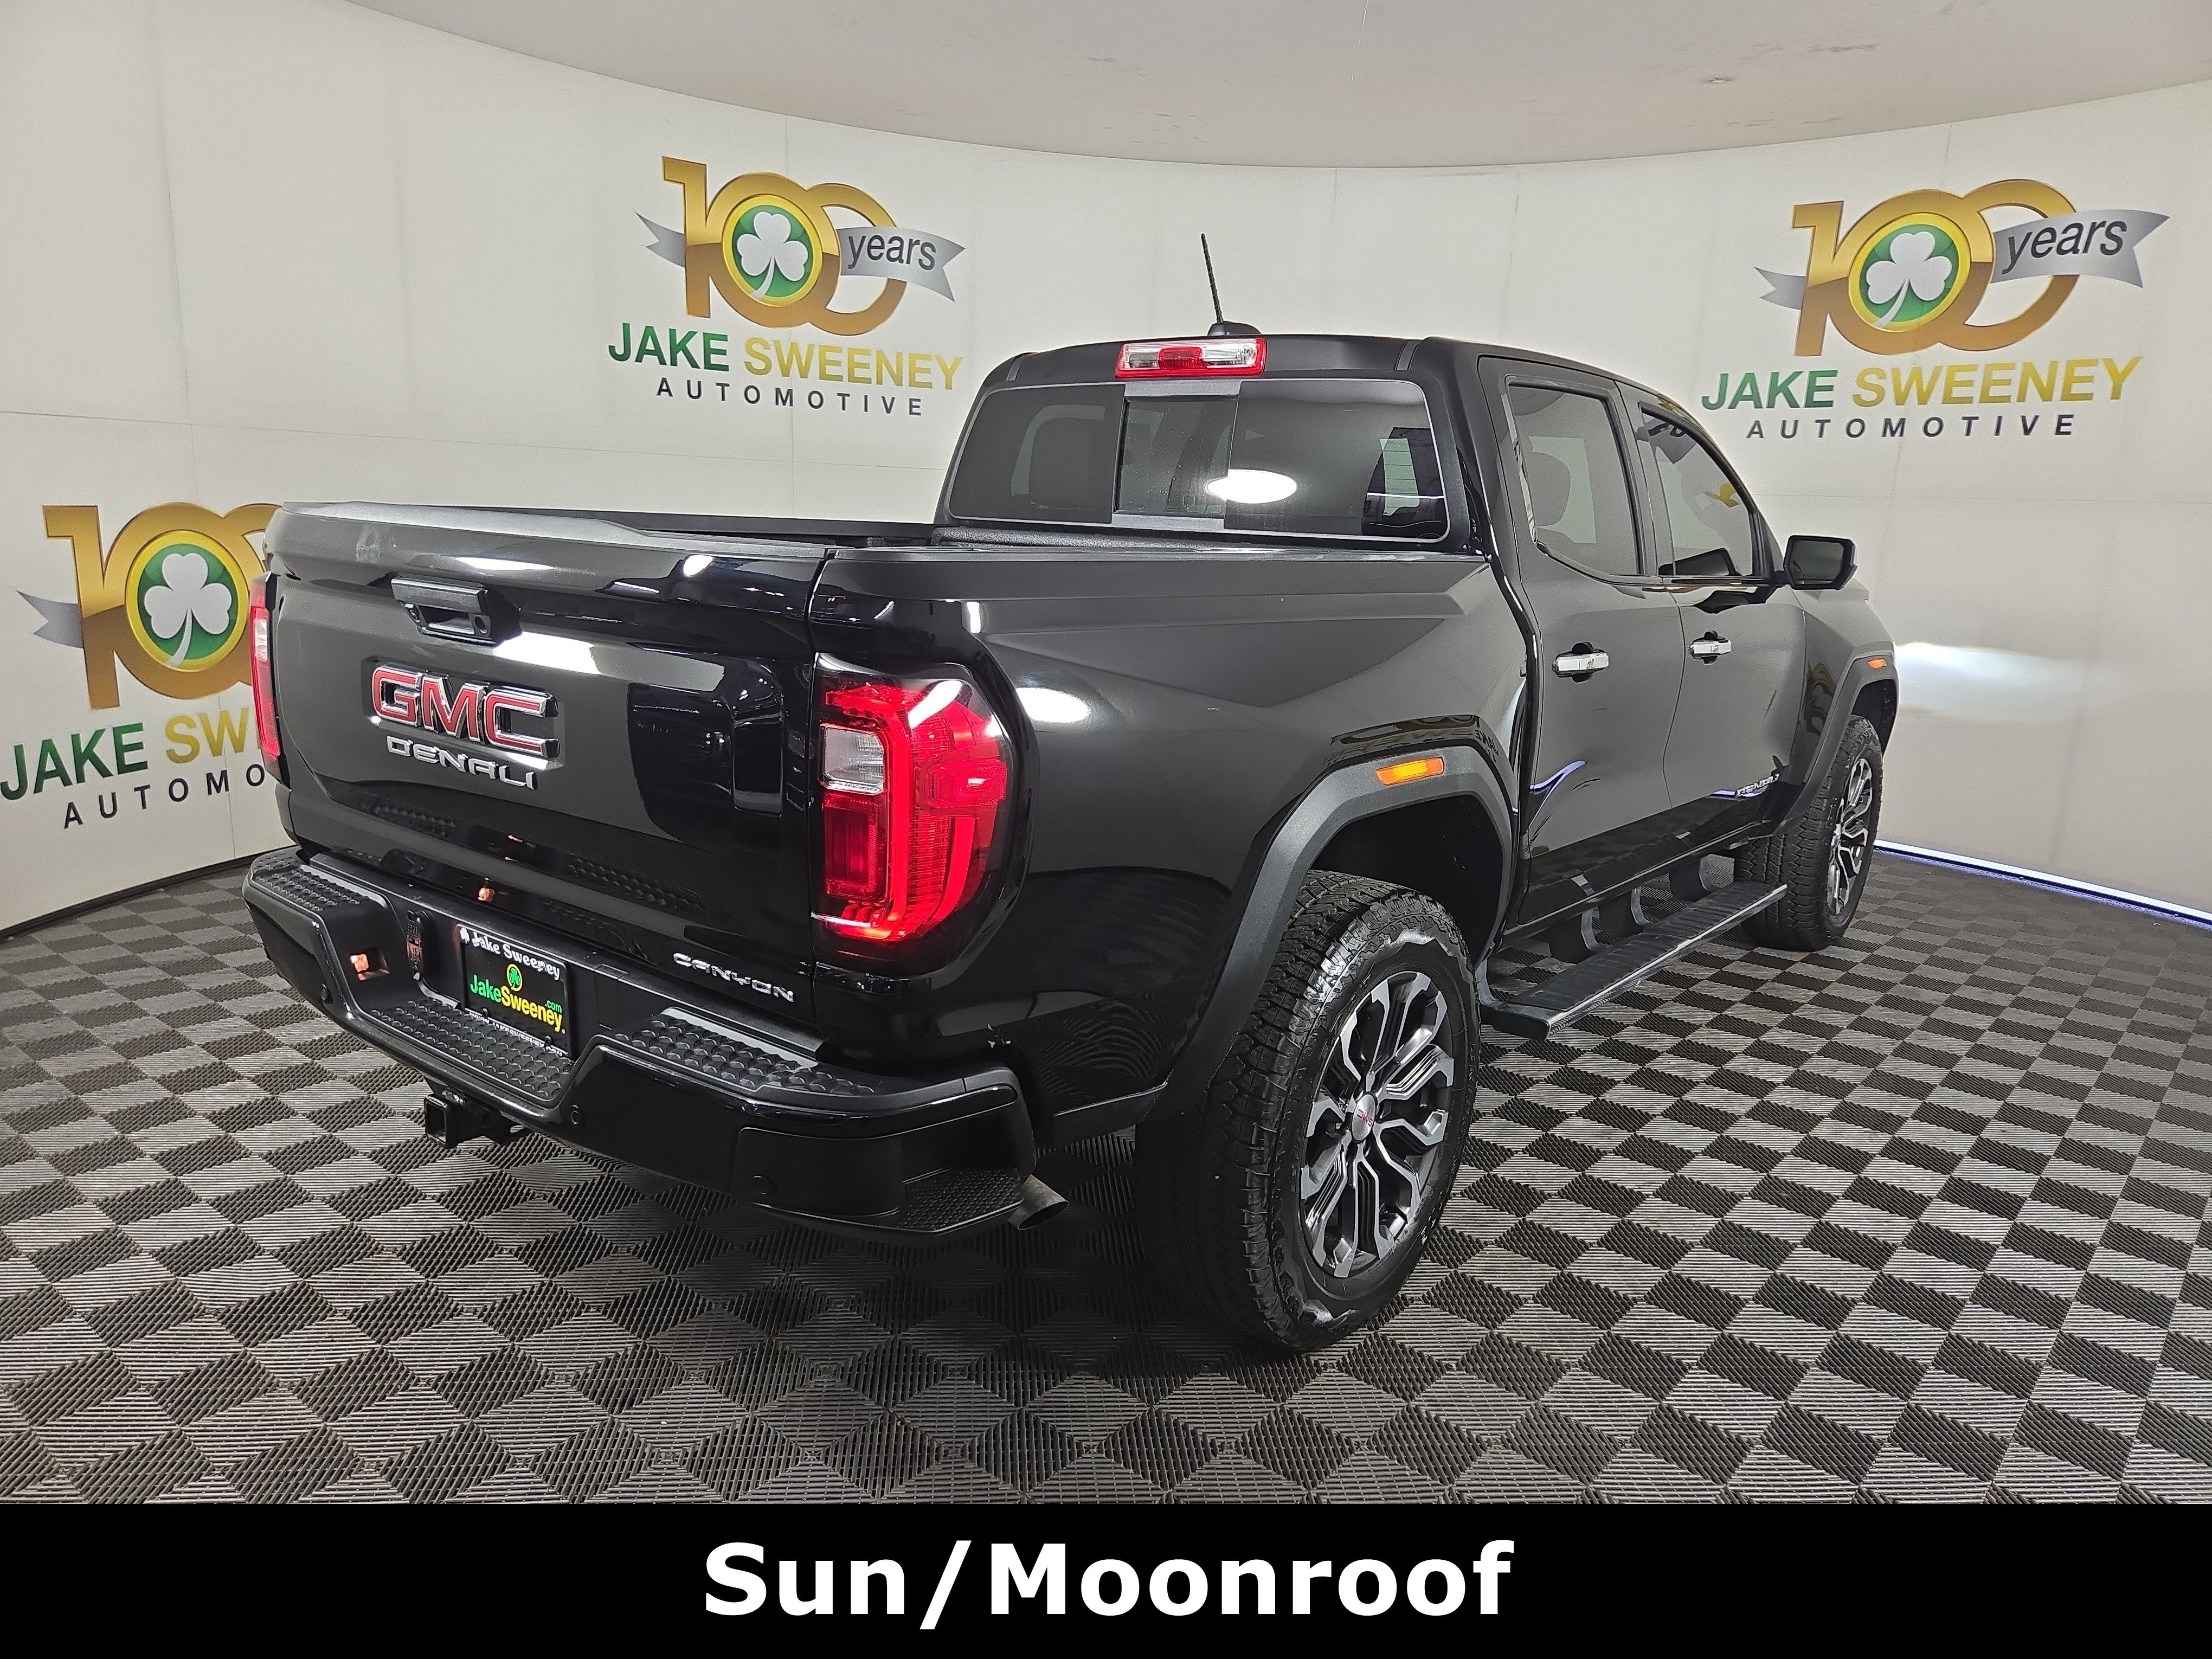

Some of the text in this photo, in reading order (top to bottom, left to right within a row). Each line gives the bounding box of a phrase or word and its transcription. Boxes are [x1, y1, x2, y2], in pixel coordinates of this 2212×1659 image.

[661, 156, 909, 336] 100
[847, 233, 937, 271] years
[1791, 179, 2082, 357] 100
[2001, 219, 2128, 275] years
[608, 323, 966, 390] JAKE SWEENEY
[1701, 356, 2142, 410] JAKE SWEENEY
[657, 377, 922, 416] AUTOMOTIVE
[1746, 414, 2075, 439] AUTOMOTIVE
[371, 664, 562, 758] GMC
[0, 722, 148, 800] JAKE
[387, 735, 538, 790] DENALI
[64, 763, 265, 829] AUTOMO
[472, 931, 560, 981] Jake Sweeney
[673, 953, 794, 1003] CANYON
[1356, 1108, 1373, 1127] GMC
